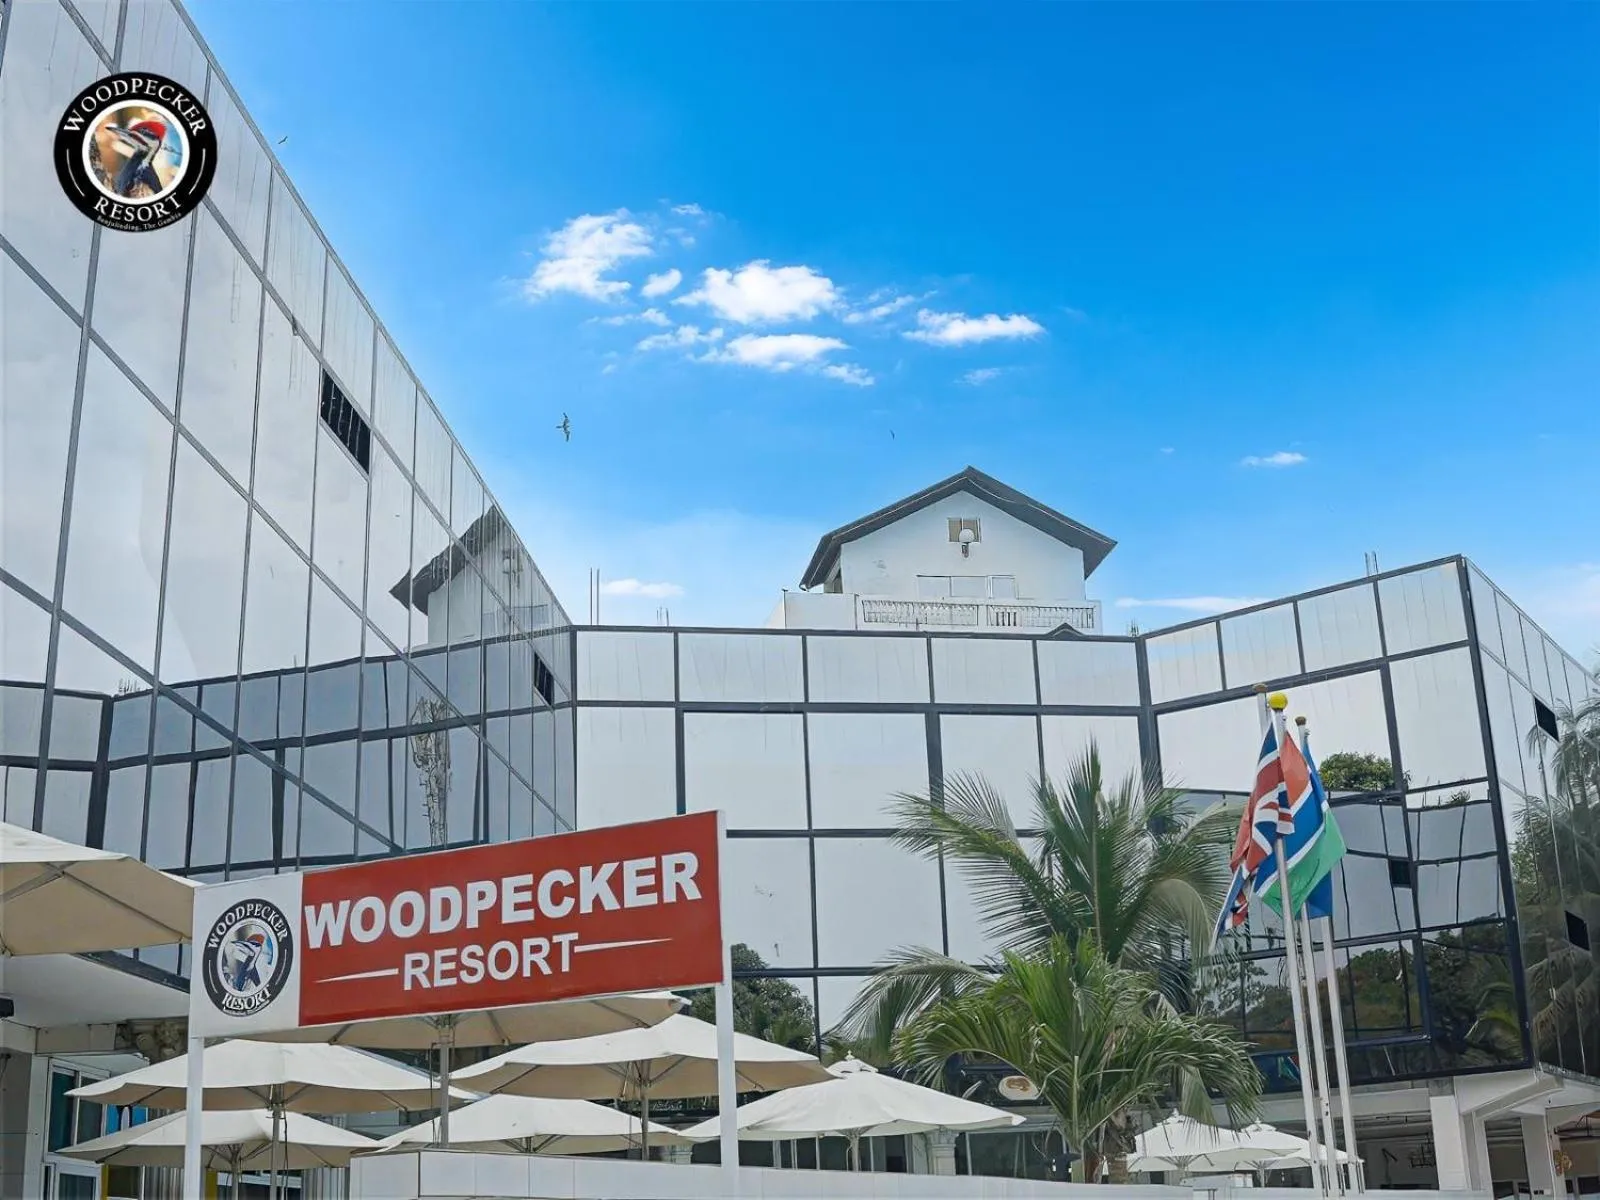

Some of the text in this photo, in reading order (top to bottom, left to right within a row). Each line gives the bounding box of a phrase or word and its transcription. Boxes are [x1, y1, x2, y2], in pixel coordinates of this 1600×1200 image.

[208, 903, 288, 948] WOODPECKER
[304, 851, 703, 949] WOODPECKER
[403, 932, 578, 990] RESORT
[222, 984, 272, 1010] RESORT
